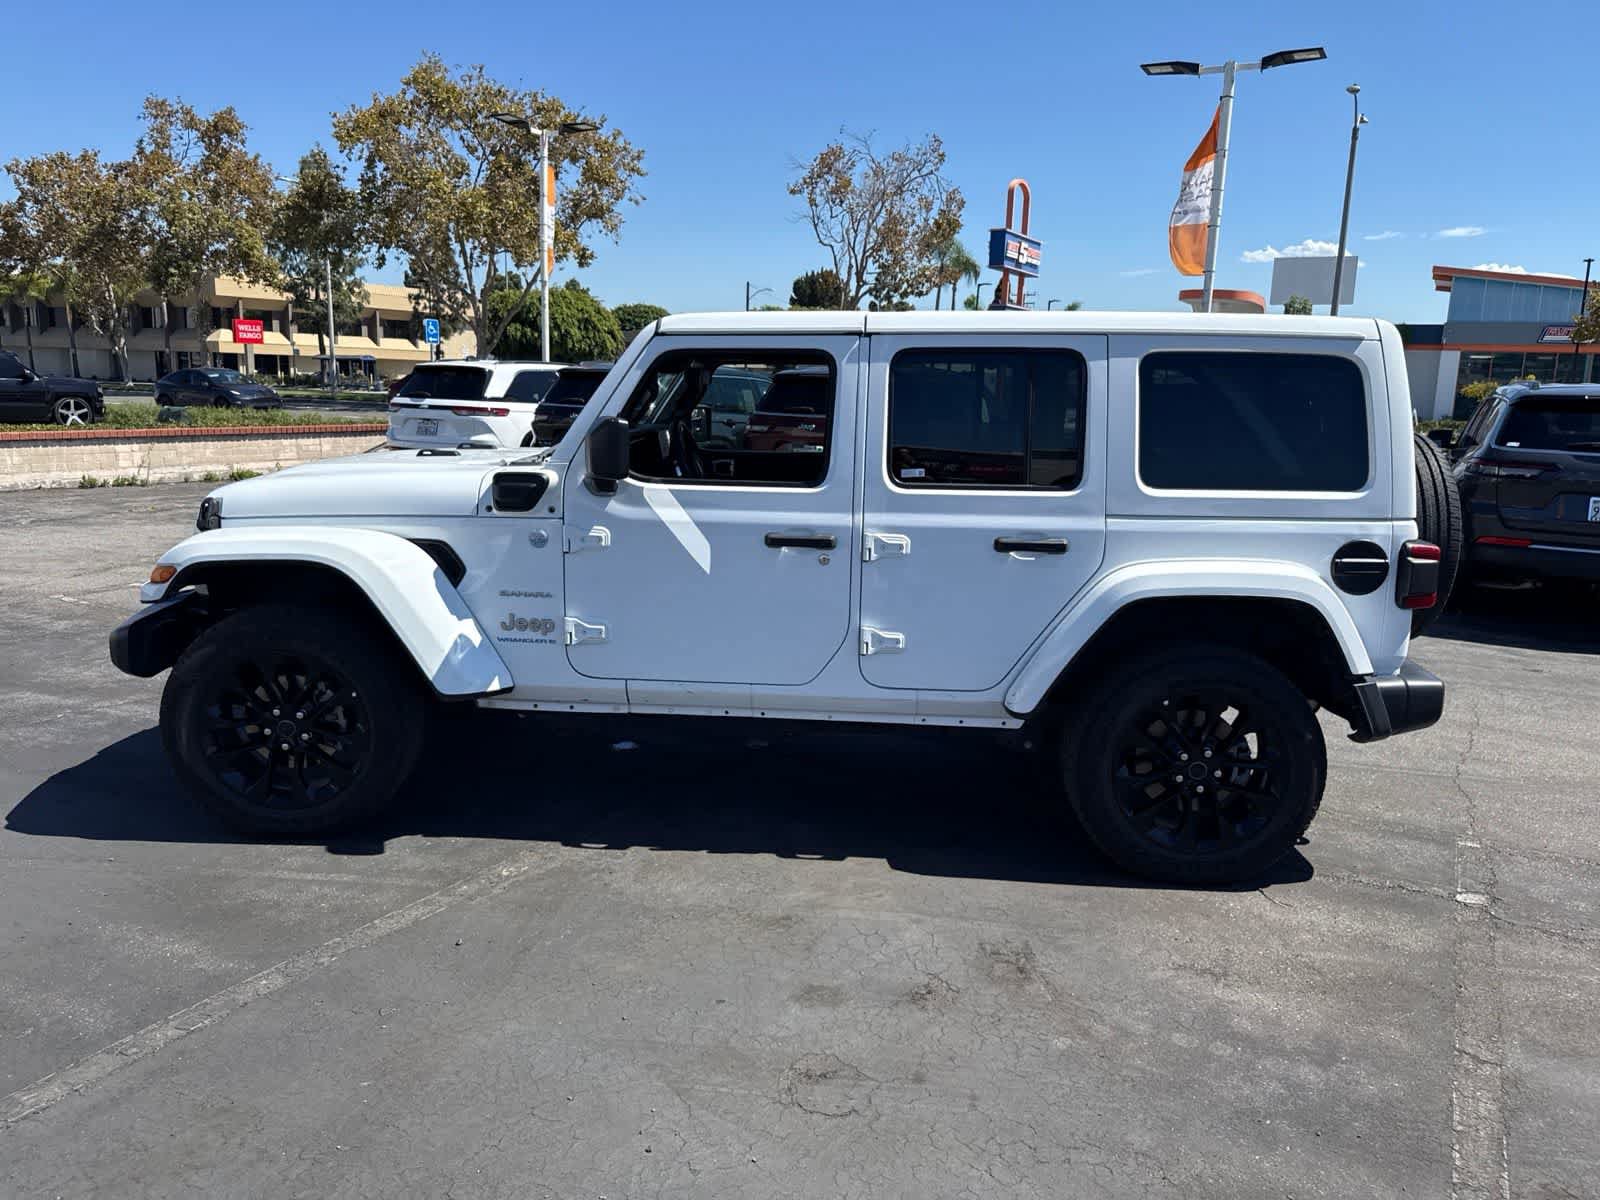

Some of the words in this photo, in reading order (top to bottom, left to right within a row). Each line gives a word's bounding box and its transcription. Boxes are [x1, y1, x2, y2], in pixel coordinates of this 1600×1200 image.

[499, 590, 553, 599] SAHARA
[500, 612, 556, 636] Jeep
[496, 636, 548, 644] WRANGLER
